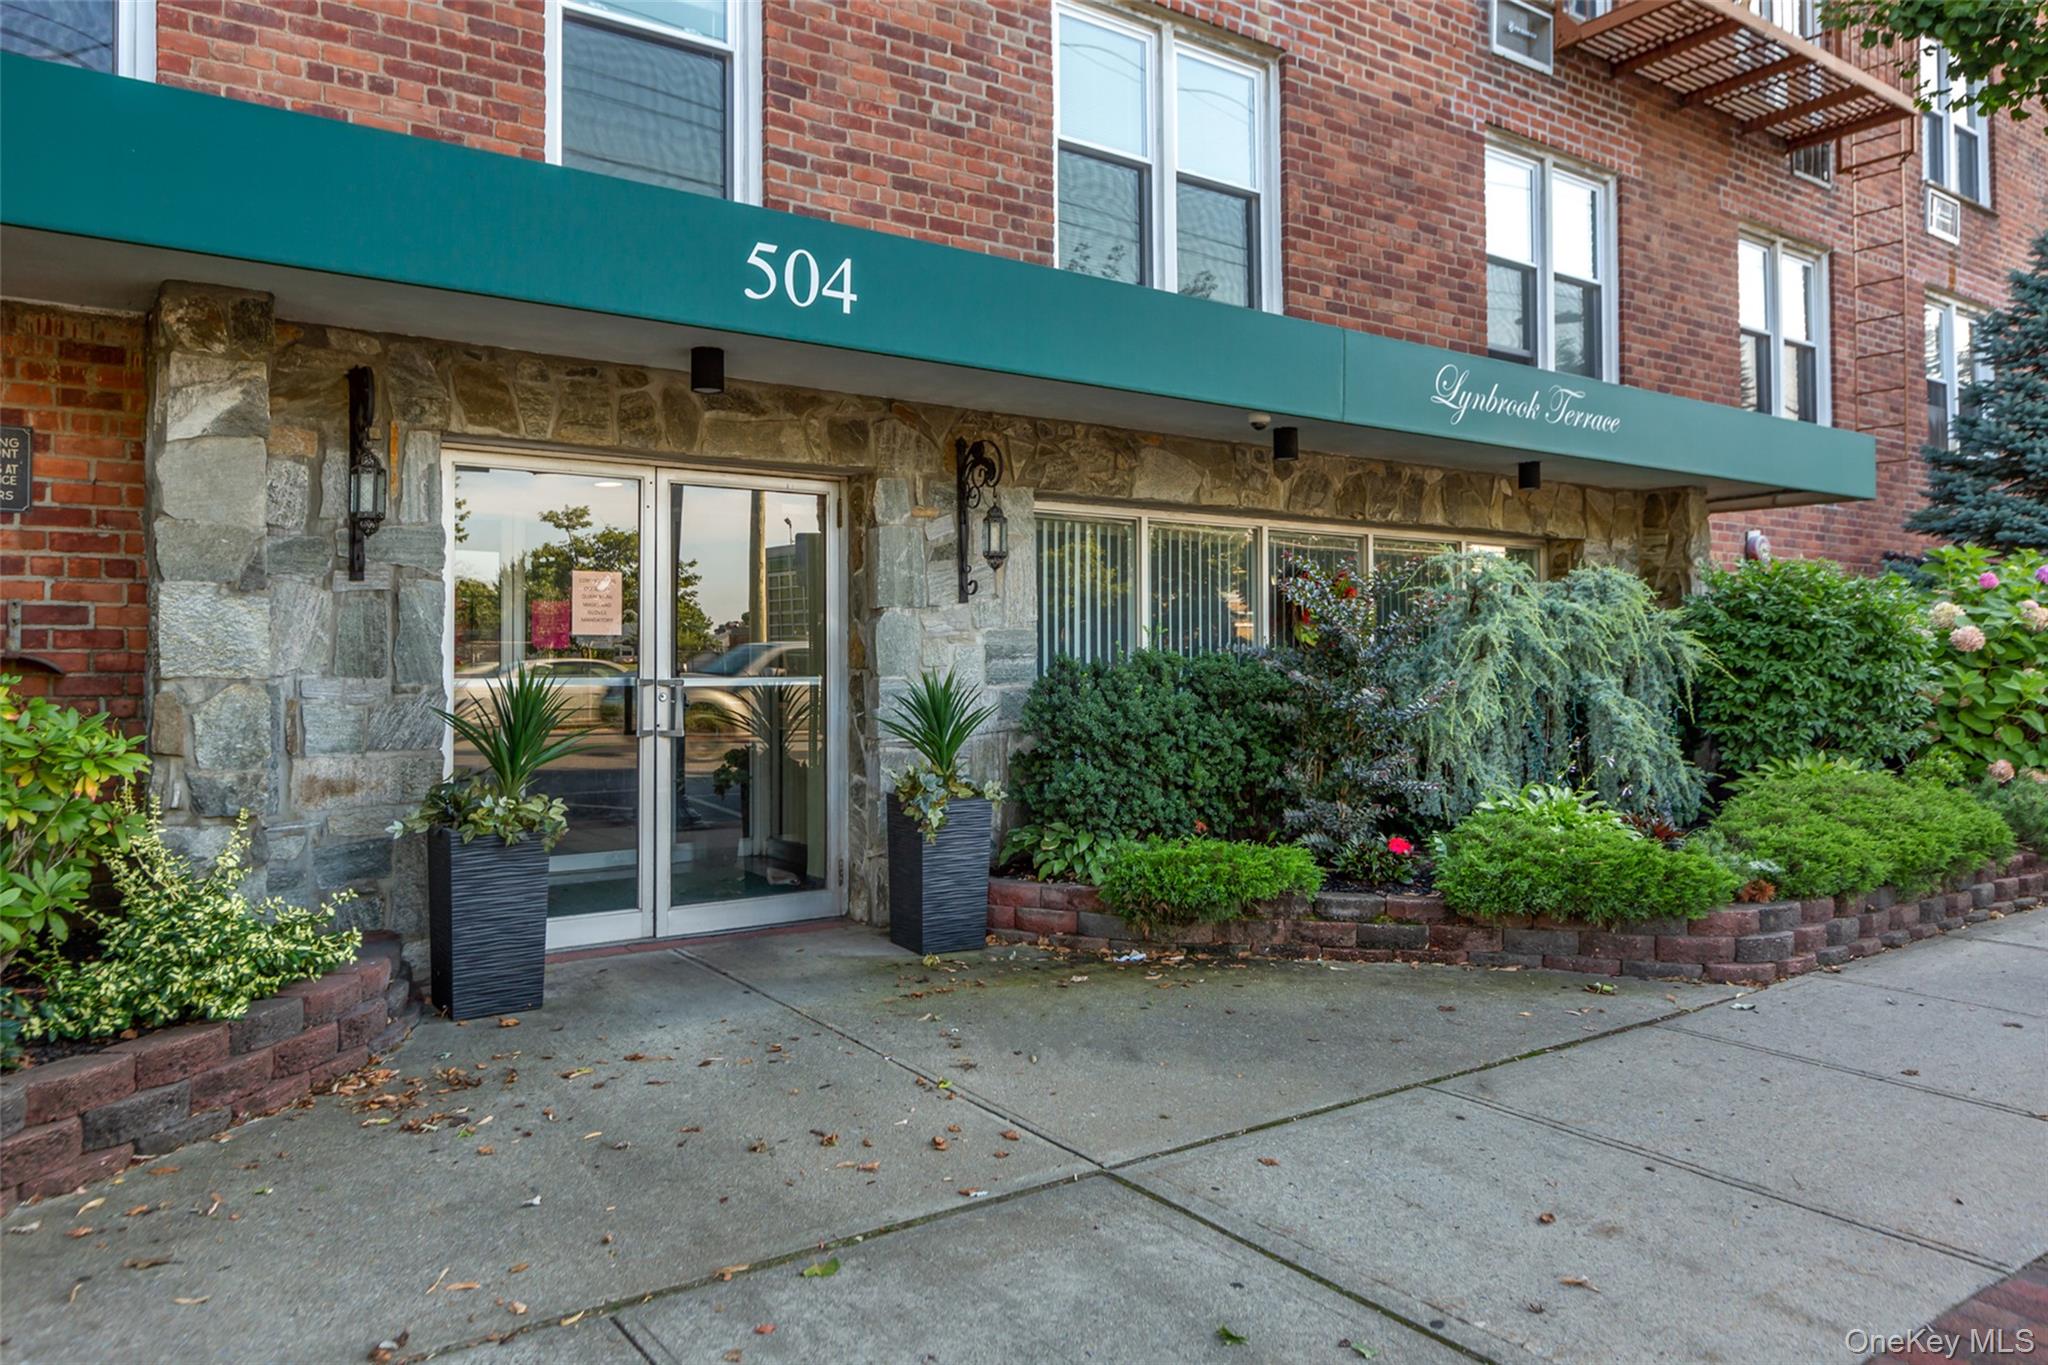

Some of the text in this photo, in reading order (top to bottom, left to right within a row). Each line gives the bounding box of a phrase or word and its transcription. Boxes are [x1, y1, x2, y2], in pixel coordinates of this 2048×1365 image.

[744, 242, 858, 314] 504
[1430, 363, 1621, 434] Lynbrook Terrace
[5, 464, 19, 475] AT
